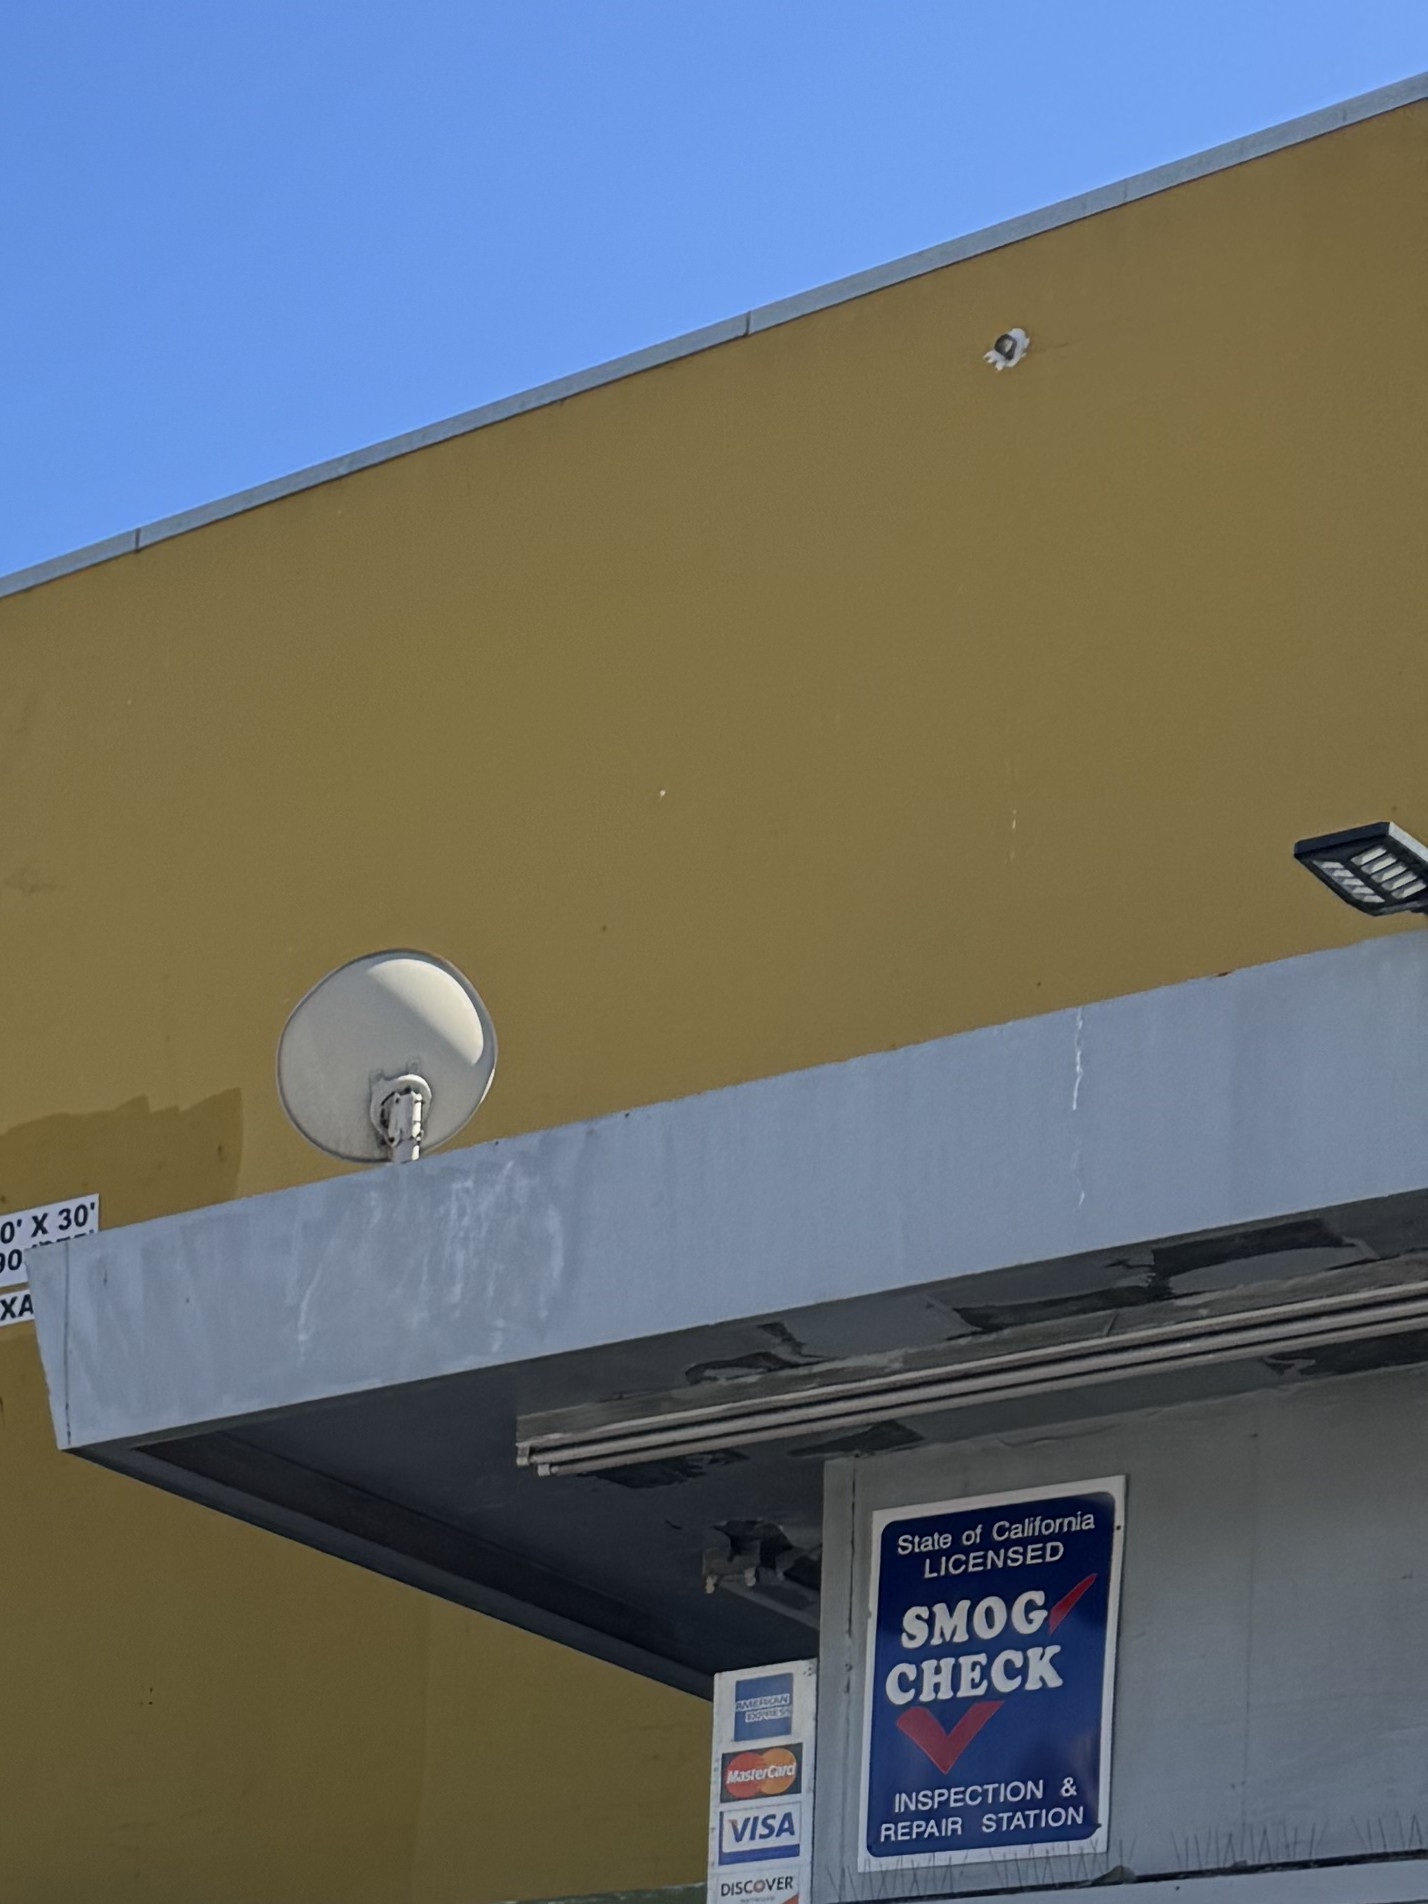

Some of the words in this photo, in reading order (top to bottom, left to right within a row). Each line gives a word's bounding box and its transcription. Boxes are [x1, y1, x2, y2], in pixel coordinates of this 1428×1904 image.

[31, 1213, 49, 1238] X
[58, 1202, 95, 1231] 30'
[897, 1530, 953, 1555] State
[962, 1524, 983, 1546] of
[992, 1511, 1096, 1541] California
[924, 1541, 1064, 1579] LICENSED
[901, 1590, 1048, 1649] SMOG
[885, 1645, 1063, 1705] CHECK
[726, 1763, 797, 1784] MasterCard
[894, 1779, 1044, 1813] INSPECTION
[1061, 1777, 1077, 1797] &
[728, 1811, 796, 1843] VISA
[880, 1817, 962, 1842] REPAIR
[982, 1806, 1084, 1833] STATION
[720, 1876, 794, 1897] DISCOVER
